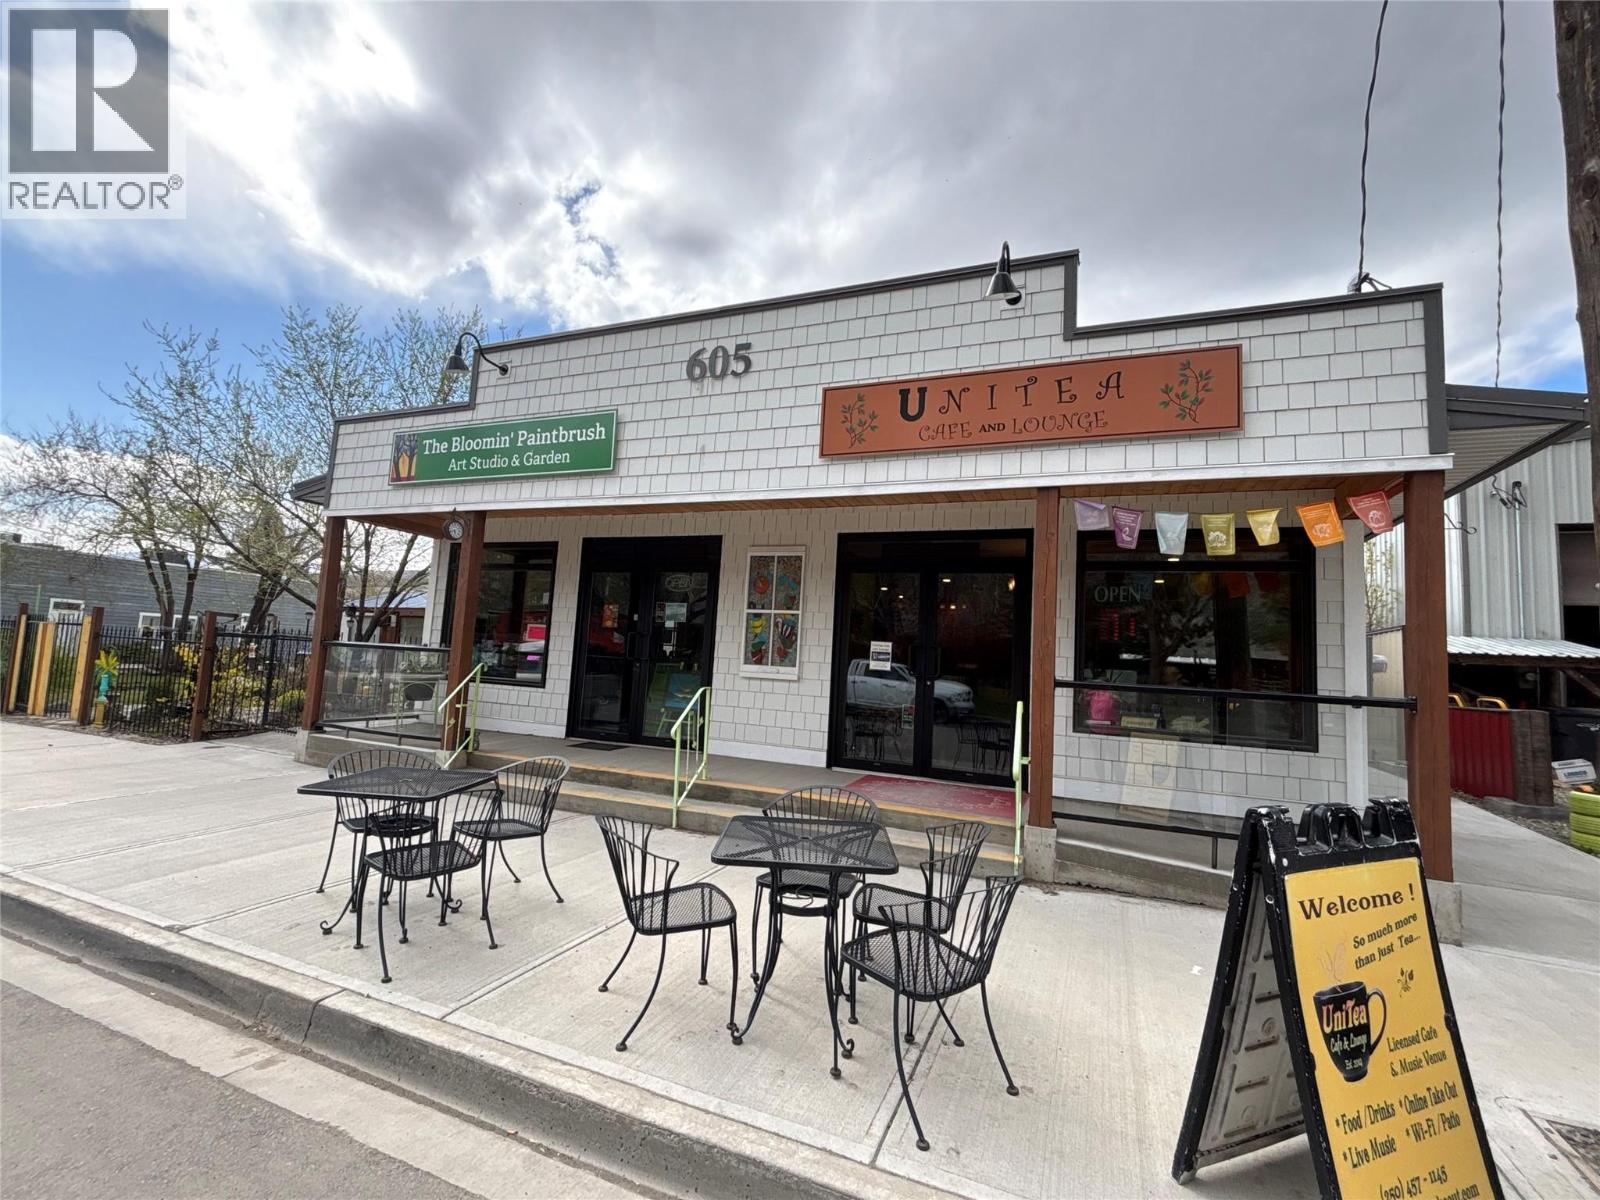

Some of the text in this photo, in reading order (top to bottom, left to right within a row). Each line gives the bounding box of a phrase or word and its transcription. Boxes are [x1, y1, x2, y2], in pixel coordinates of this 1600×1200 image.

[686, 342, 752, 383] 605
[898, 370, 1125, 422] UNITEA
[423, 422, 606, 455] The Bloomin' Paintbrush
[918, 410, 1108, 441] CAFE AND LOUNGE
[448, 450, 570, 472] Art Studio & Garden
[1094, 585, 1141, 602] OPEN
[1297, 890, 1403, 920] Welcome
[1353, 913, 1418, 949] So much more
[1354, 952, 1376, 970] than
[1377, 942, 1395, 962] just
[1322, 998, 1367, 1034] UniTea
[1386, 1030, 1421, 1052] Licensed
[1389, 1050, 1447, 1077] & Music Venue
[1403, 1080, 1458, 1115] Online Take Out
[1341, 1109, 1363, 1135] Food
[1410, 1118, 1437, 1143] Wi-Fi
[1348, 1134, 1397, 1169] Live Music
[1406, 1176, 1422, 1198] 457
